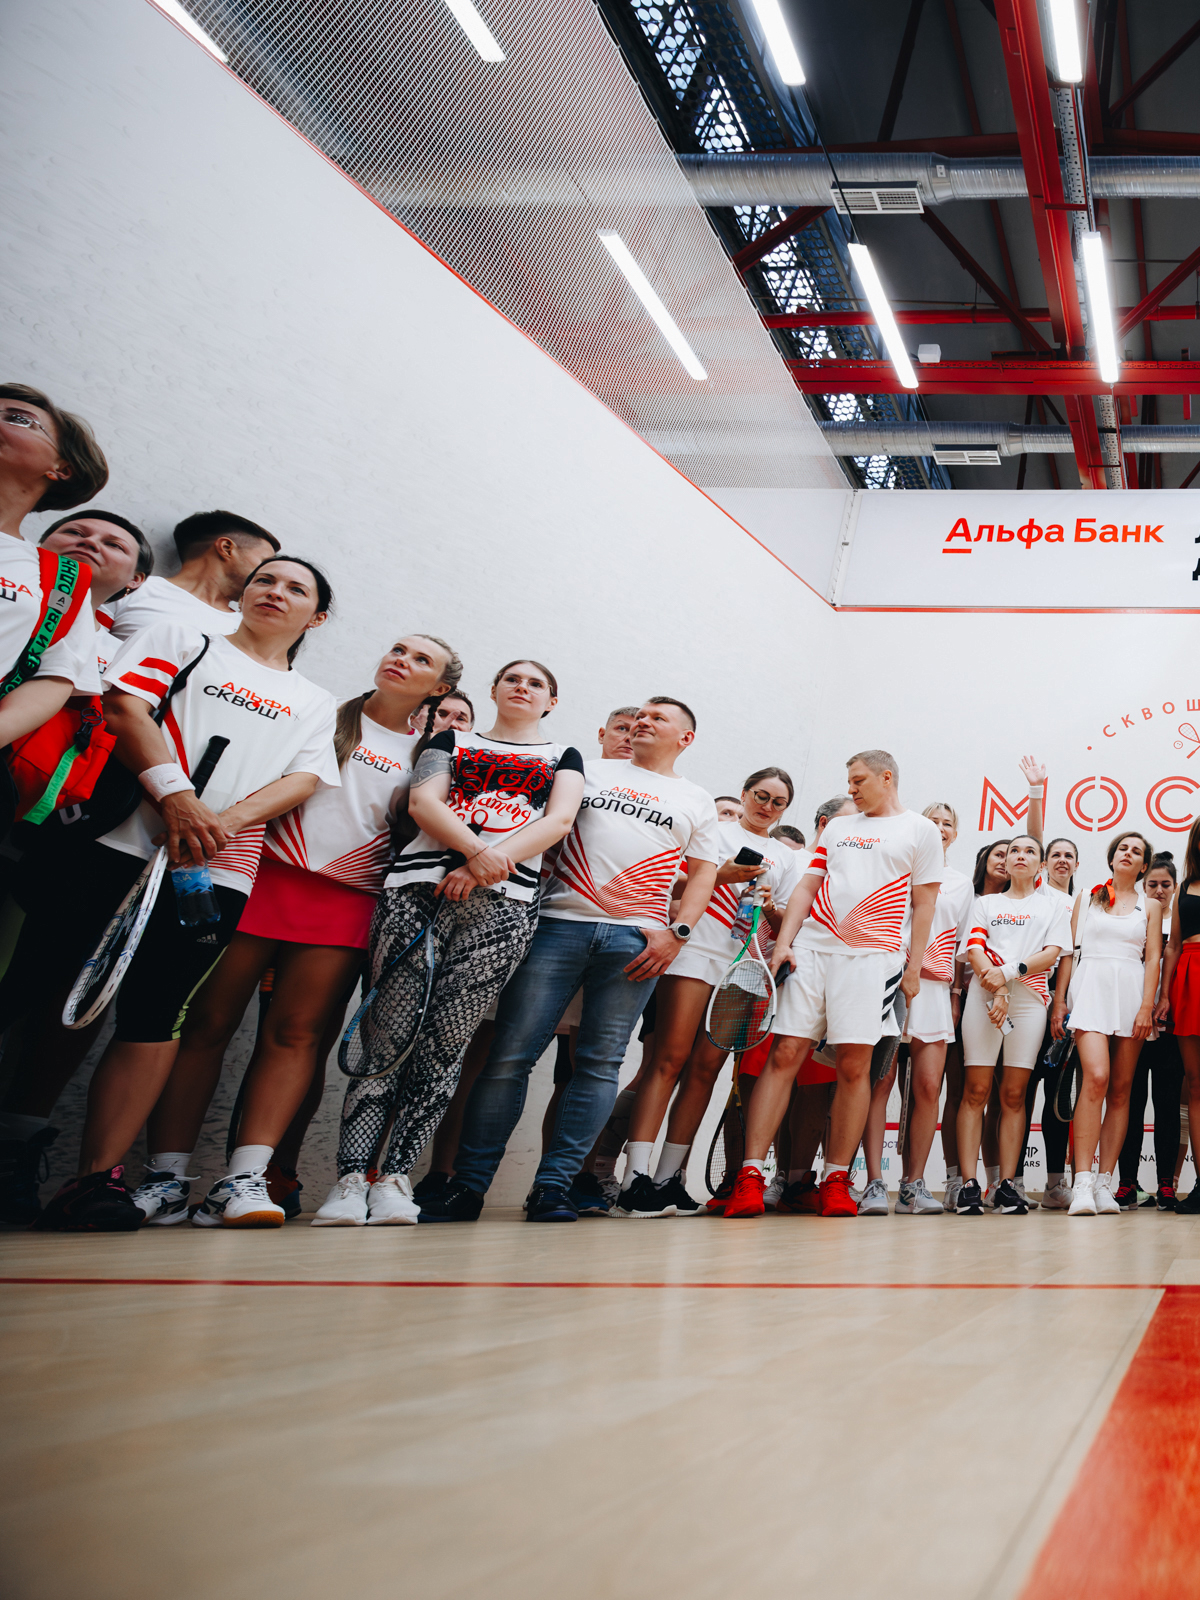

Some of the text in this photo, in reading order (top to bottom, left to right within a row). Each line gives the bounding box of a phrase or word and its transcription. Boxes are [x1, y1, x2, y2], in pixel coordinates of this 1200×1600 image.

[943, 517, 1165, 549] Альфа Банк
[203, 685, 279, 720] СКВОШ
[221, 682, 291, 717] АЛЬФА
[351, 751, 391, 773] ВОШ
[355, 745, 402, 771] ЛЬФА
[599, 790, 650, 806] СКВОШ
[611, 786, 660, 802] АЛЬФА
[580, 796, 674, 830] ВОЛОГДА
[836, 841, 873, 849] СКВОШ
[991, 918, 1025, 926] СКВОШ
[1023, 1160, 1041, 1168] ARS
